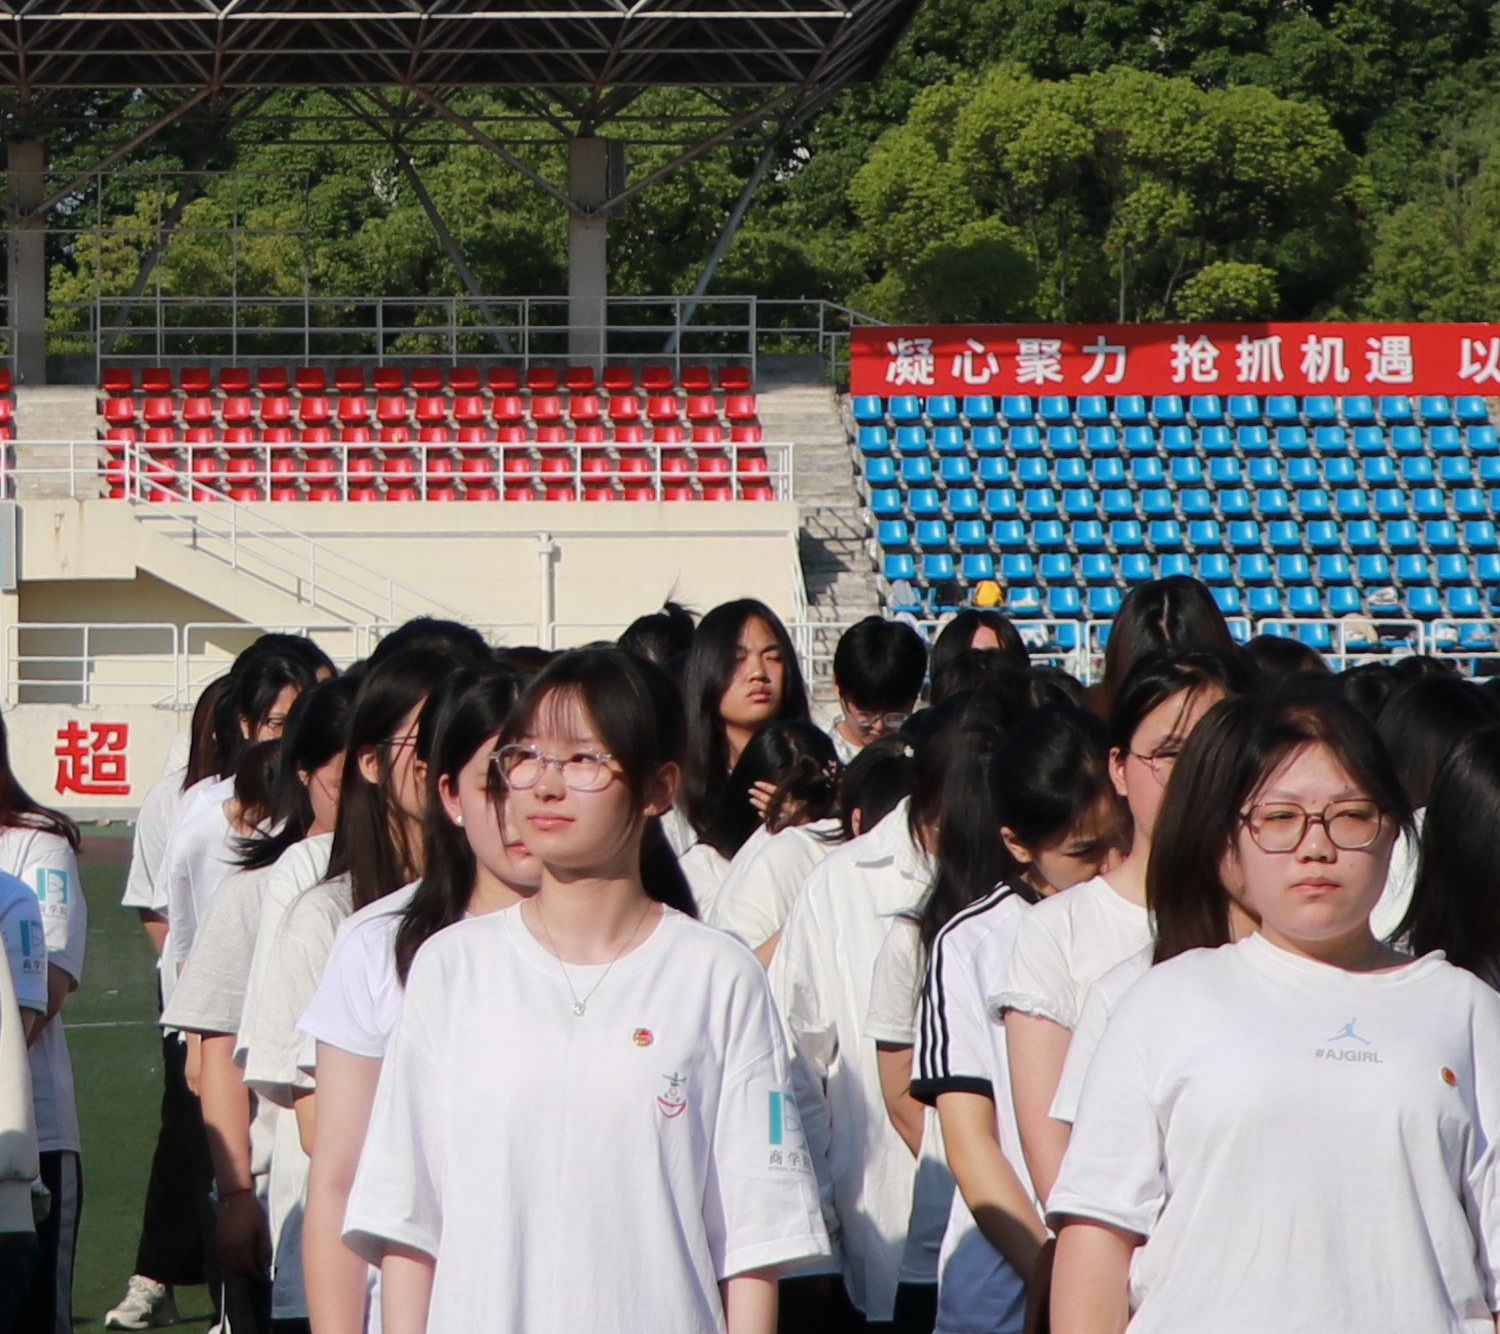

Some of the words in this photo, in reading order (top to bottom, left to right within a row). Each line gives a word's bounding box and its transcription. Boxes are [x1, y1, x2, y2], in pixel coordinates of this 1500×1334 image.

[885, 337, 1128, 386] 凝心聚力
[1171, 334, 1414, 384] 抢抓机遇
[55, 720, 132, 795] 超
[1315, 1048, 1384, 1063] #AJGIRL
